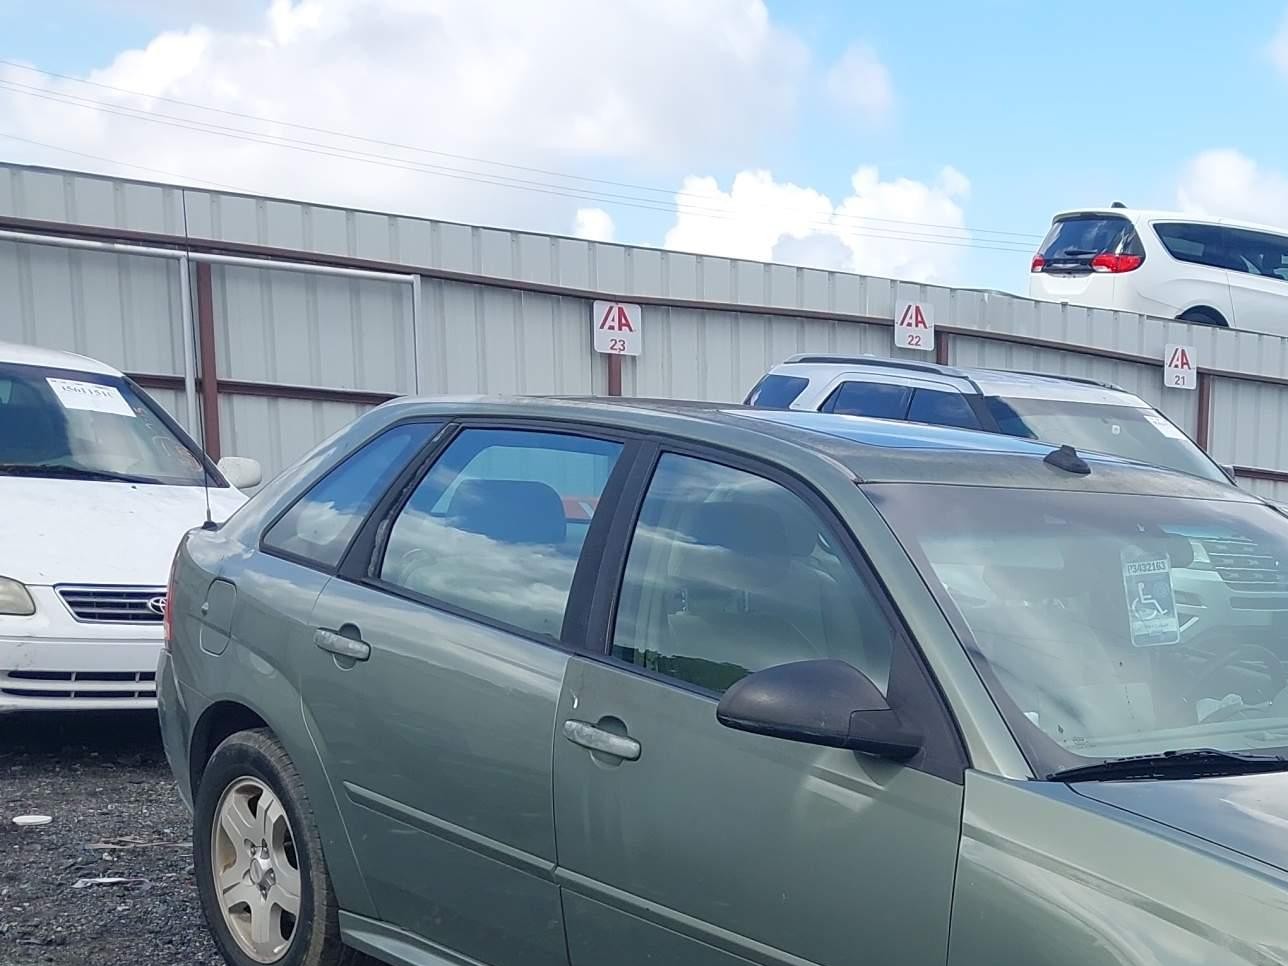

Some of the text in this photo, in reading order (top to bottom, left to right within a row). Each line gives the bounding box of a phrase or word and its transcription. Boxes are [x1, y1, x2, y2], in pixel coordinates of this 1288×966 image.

[609, 338, 626, 352] 23
[907, 334, 922, 347] 22
[1174, 374, 1185, 386] 21
